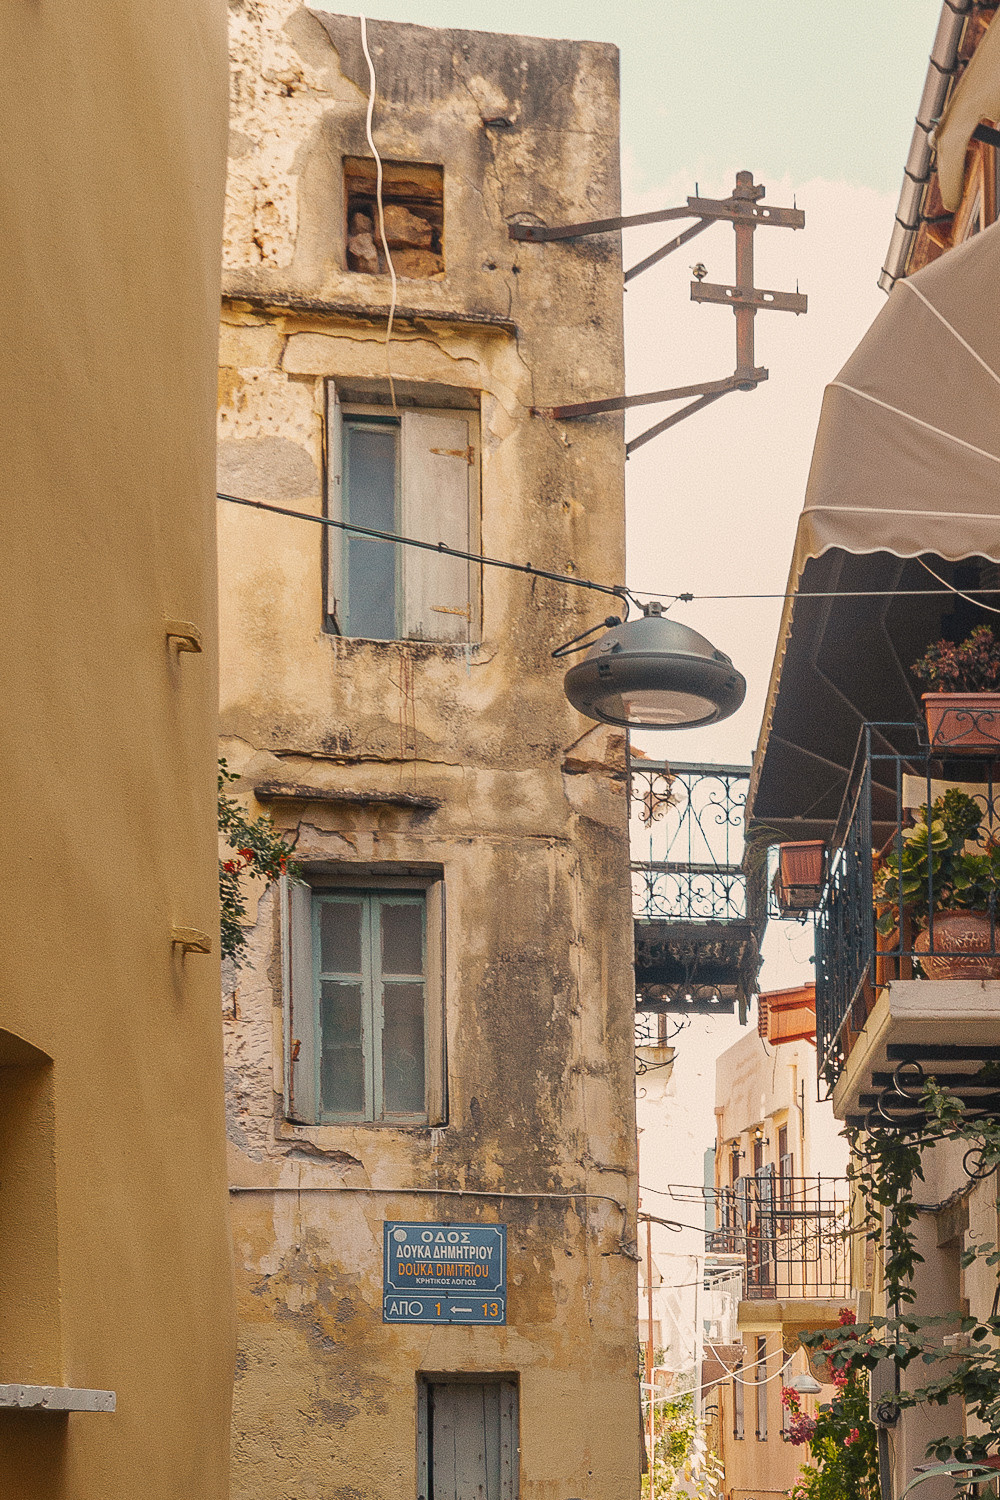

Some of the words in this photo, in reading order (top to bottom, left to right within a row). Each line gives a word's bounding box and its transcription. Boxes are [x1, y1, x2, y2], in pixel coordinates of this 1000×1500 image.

[421, 1231, 471, 1243] ΟΔΟΣ
[396, 1245, 431, 1258] ΔΟΥΚΑ
[433, 1246, 493, 1259] ΔΗΜΗΤΡΙΟΥ
[398, 1263, 433, 1276] DOUKA
[436, 1264, 489, 1277] DIMITRIOU
[415, 1277, 450, 1285] ΚΡΗΤΙΚΟΣ
[451, 1278, 477, 1286] ΛΟΓΙΟΣ
[389, 1301, 423, 1316] ΑΠΟ
[435, 1302, 441, 1316] 1
[482, 1303, 499, 1317] 13
